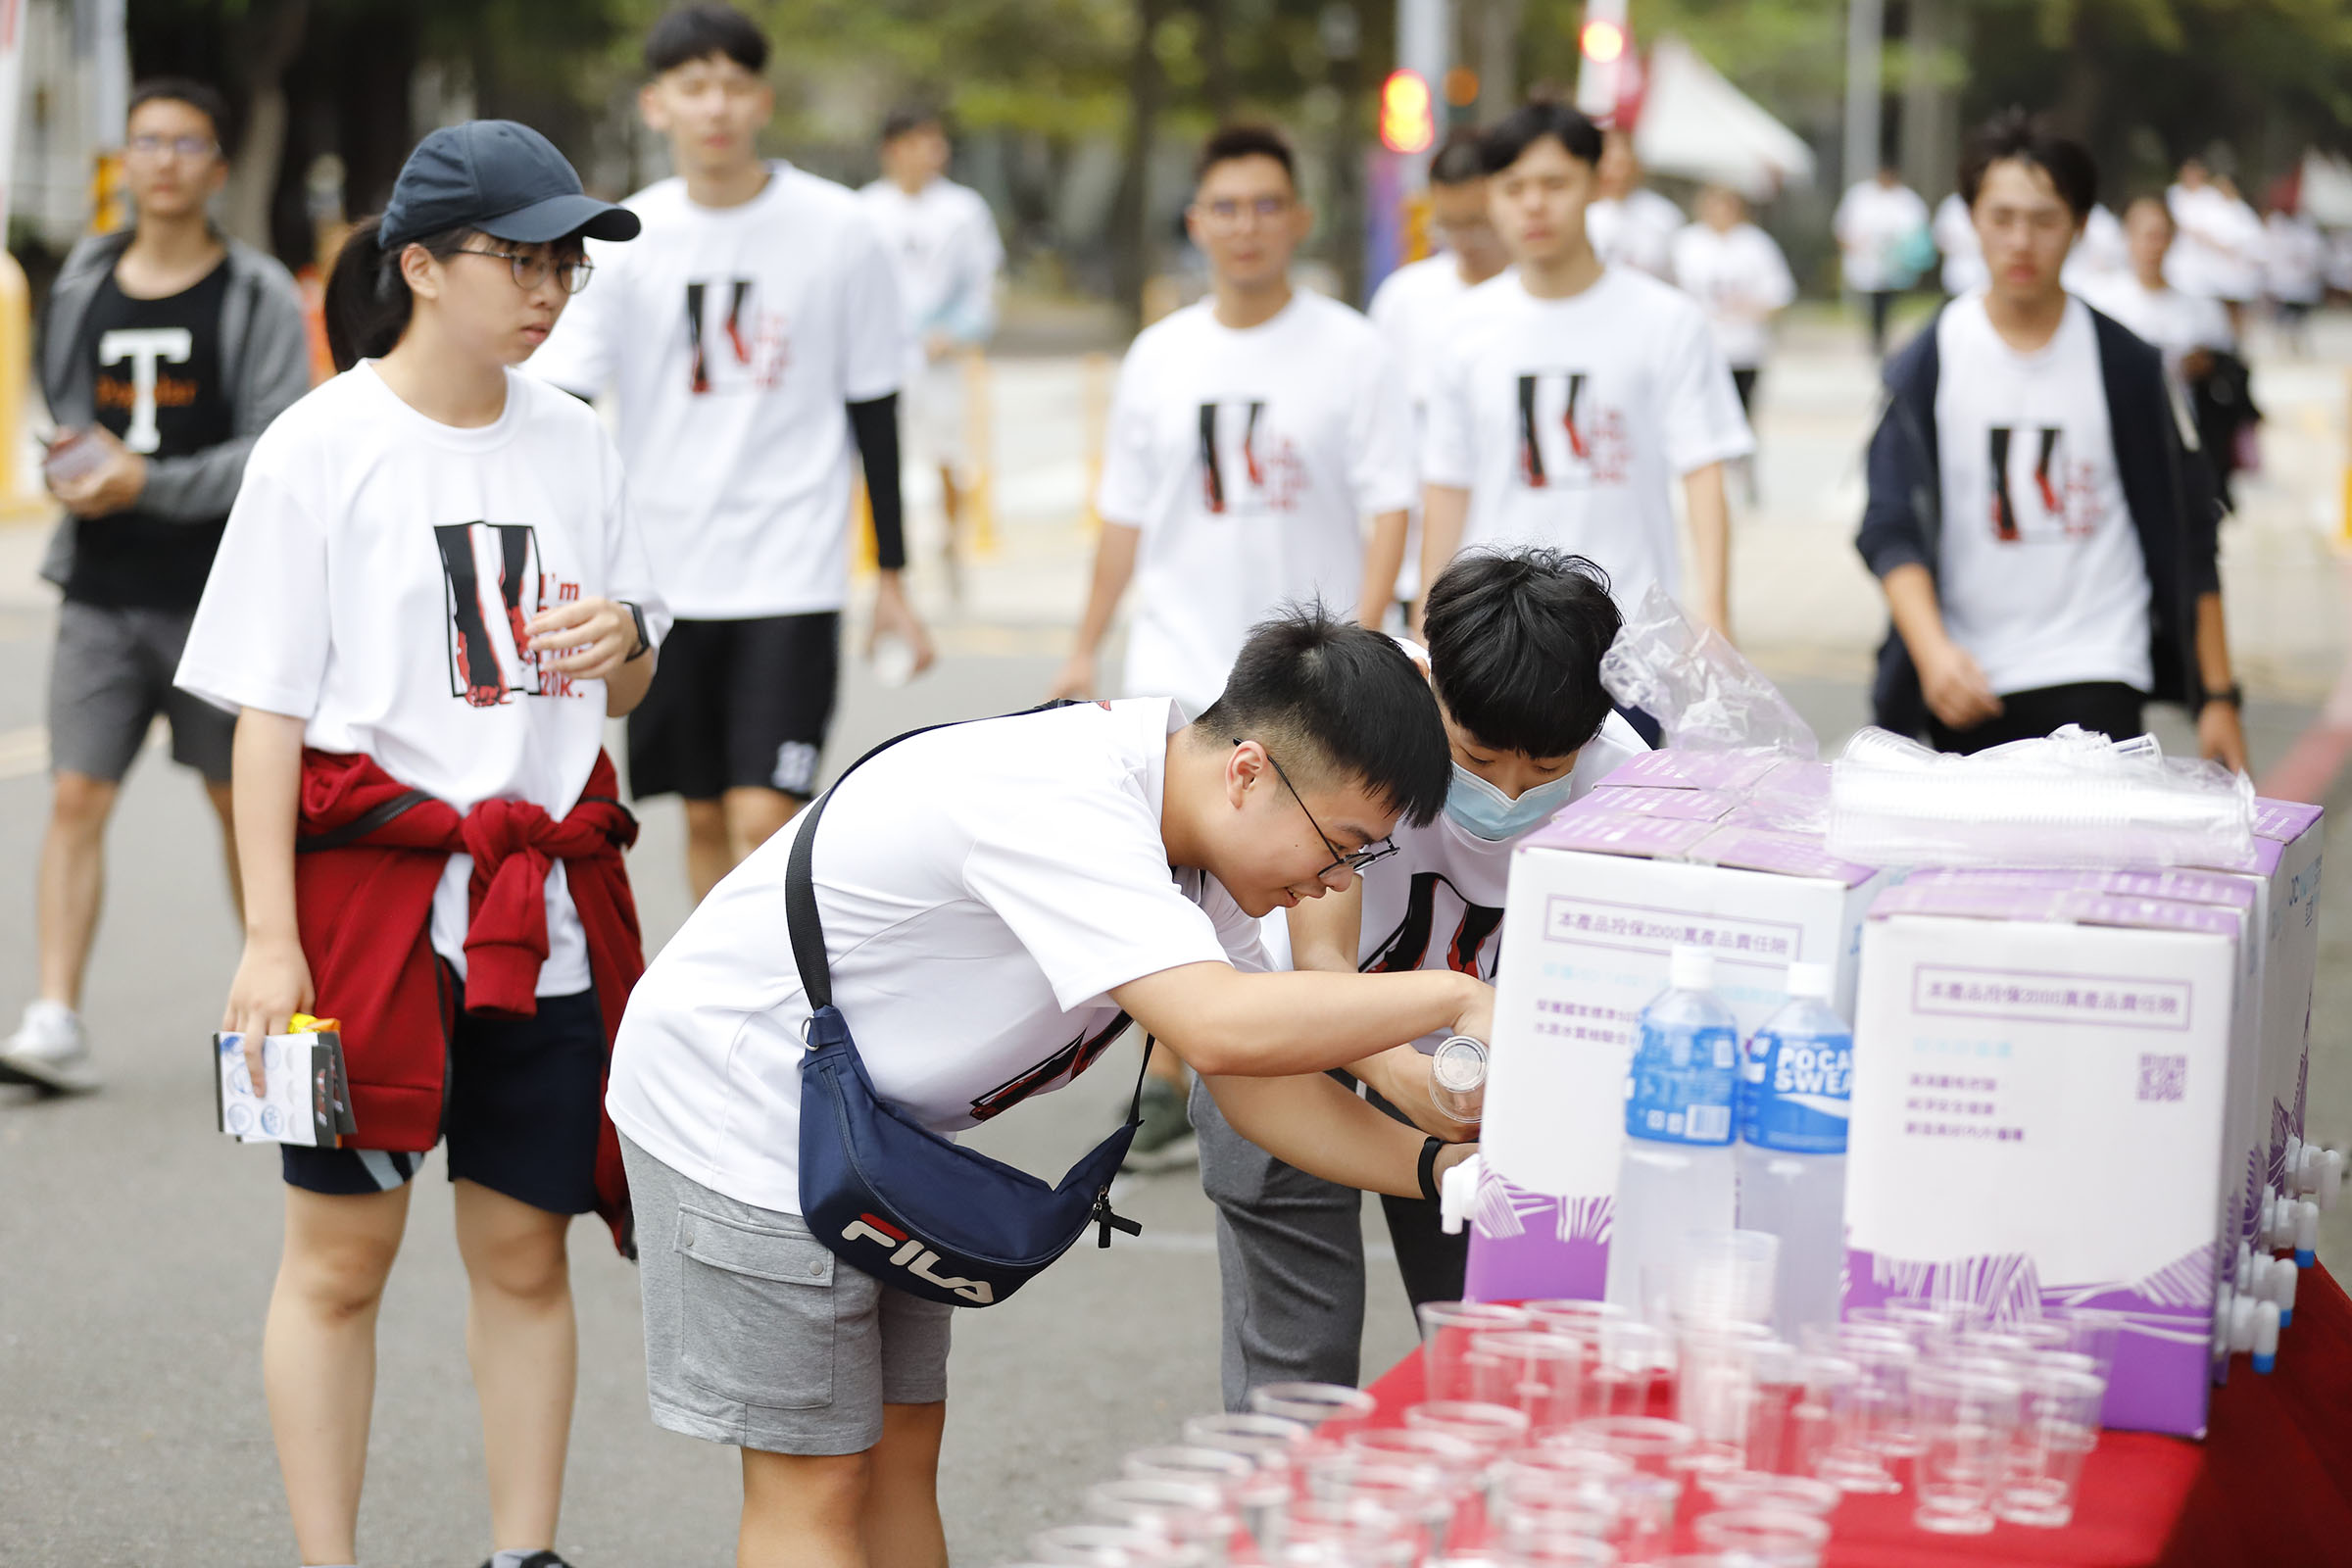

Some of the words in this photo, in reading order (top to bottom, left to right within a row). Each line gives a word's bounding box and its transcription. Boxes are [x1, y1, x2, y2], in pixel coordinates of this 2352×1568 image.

[99, 327, 192, 454] T
[539, 572, 580, 601] I'm
[841, 1212, 995, 1304] FILA
